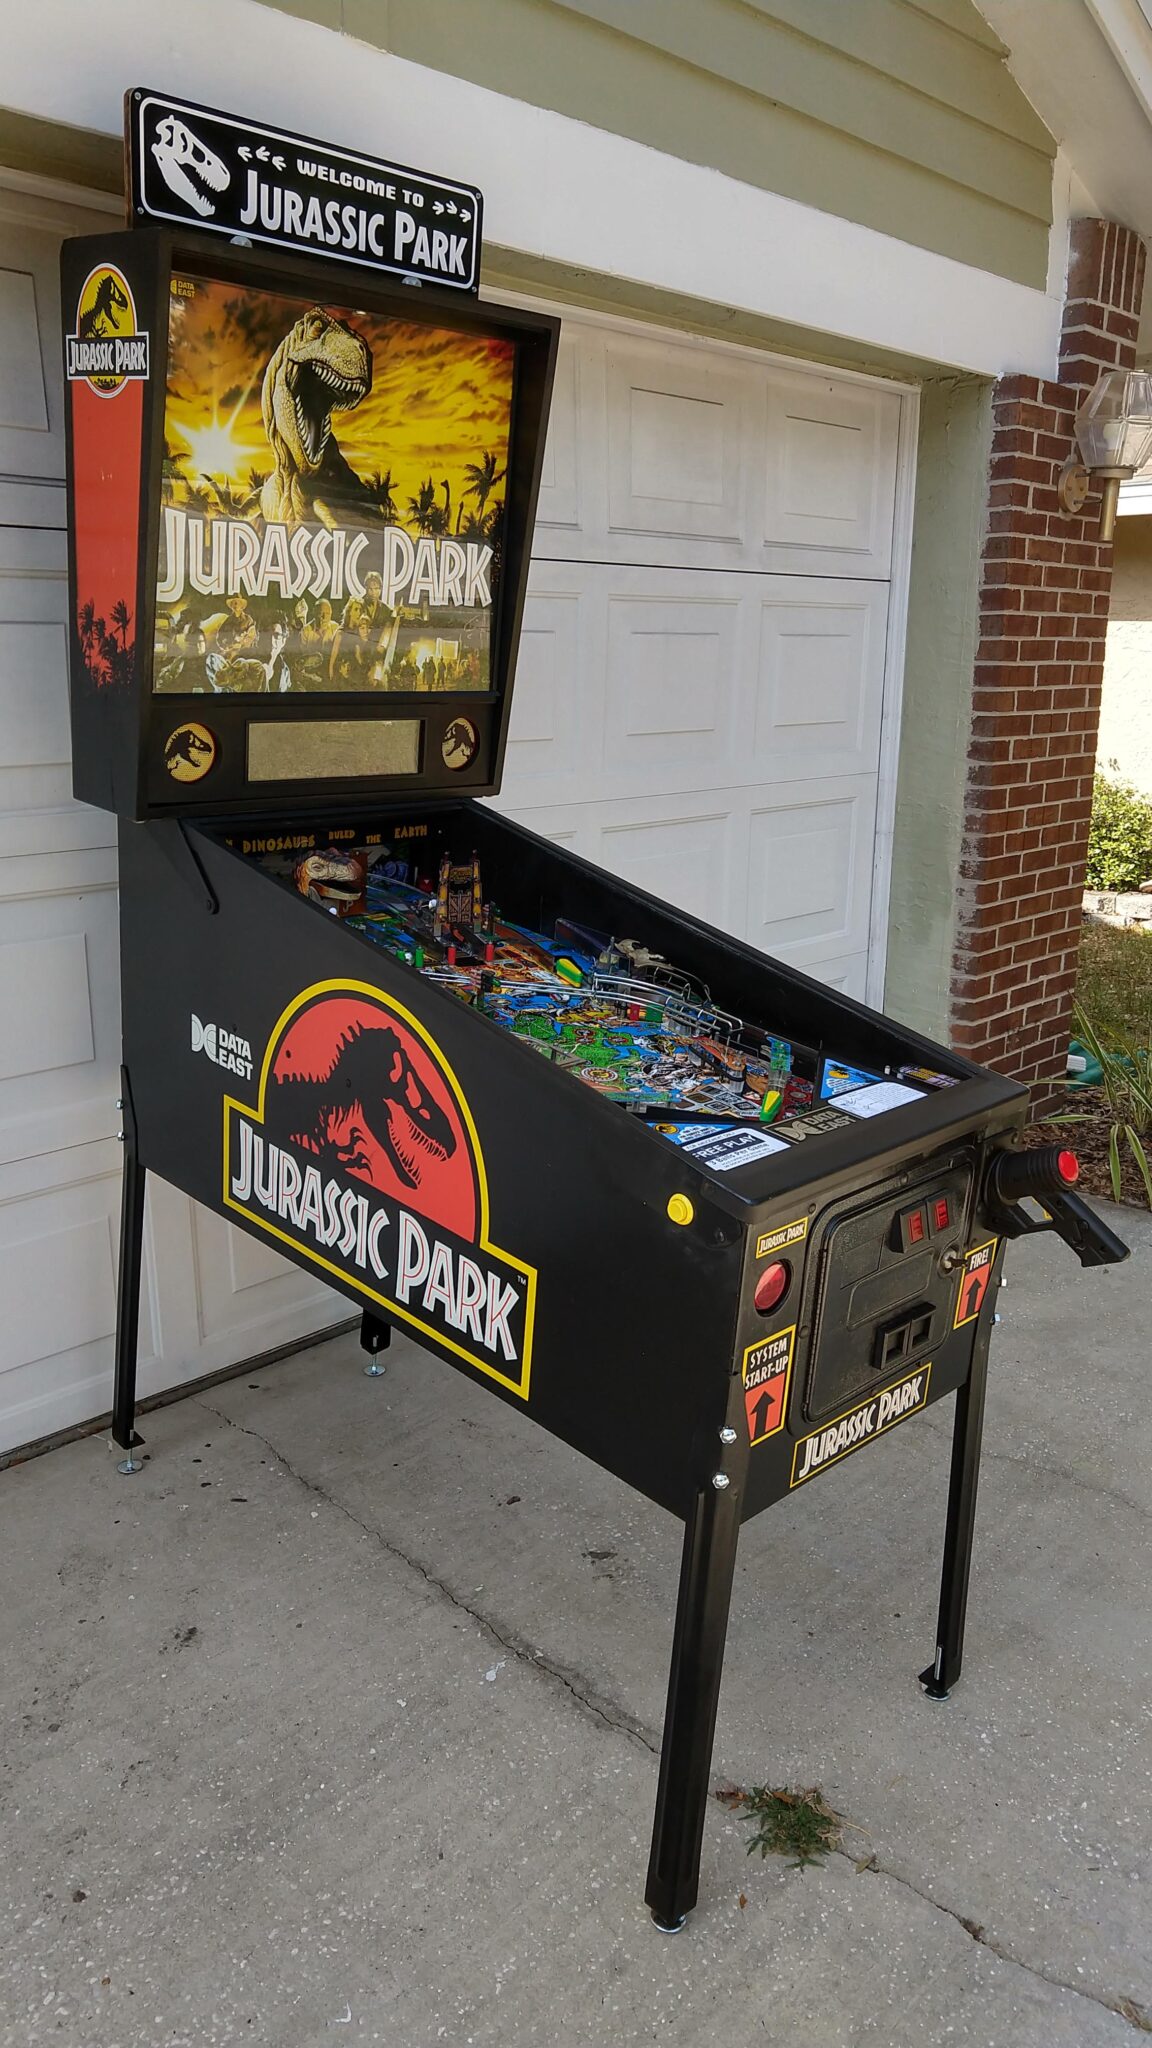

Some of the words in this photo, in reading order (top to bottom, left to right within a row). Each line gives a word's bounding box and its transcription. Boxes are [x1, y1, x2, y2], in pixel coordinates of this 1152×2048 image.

[296, 158, 397, 201] WELCOME
[402, 188, 425, 209] TO
[240, 169, 385, 257] JURASSIC
[394, 210, 468, 277] PARK
[177, 280, 195, 290] DATA
[177, 288, 196, 299] EAST
[69, 340, 114, 375] JURASSIC
[115, 338, 146, 374] PARK
[156, 507, 370, 602] JURASSIC
[381, 526, 495, 608] PARK
[242, 834, 316, 854] DINOSAURS
[328, 829, 356, 841] RULED
[366, 834, 382, 844] THE
[394, 824, 428, 839] EARTH
[219, 1027, 252, 1061] DATA
[219, 1047, 254, 1081] EAST
[802, 1110, 841, 1125] DATA
[816, 1115, 856, 1132] EAST
[723, 1134, 757, 1149] PLAY
[232, 1118, 390, 1280] JURASSIC
[395, 1209, 520, 1361] PARK
[758, 1231, 787, 1254] JURASSIC
[786, 1223, 805, 1242] PARK
[969, 1248, 990, 1271] FIRE!
[750, 1337, 788, 1369] SYSTEM
[744, 1355, 789, 1391] START-UP
[798, 1403, 877, 1479] JURASSIC
[876, 1375, 923, 1430] PARK
